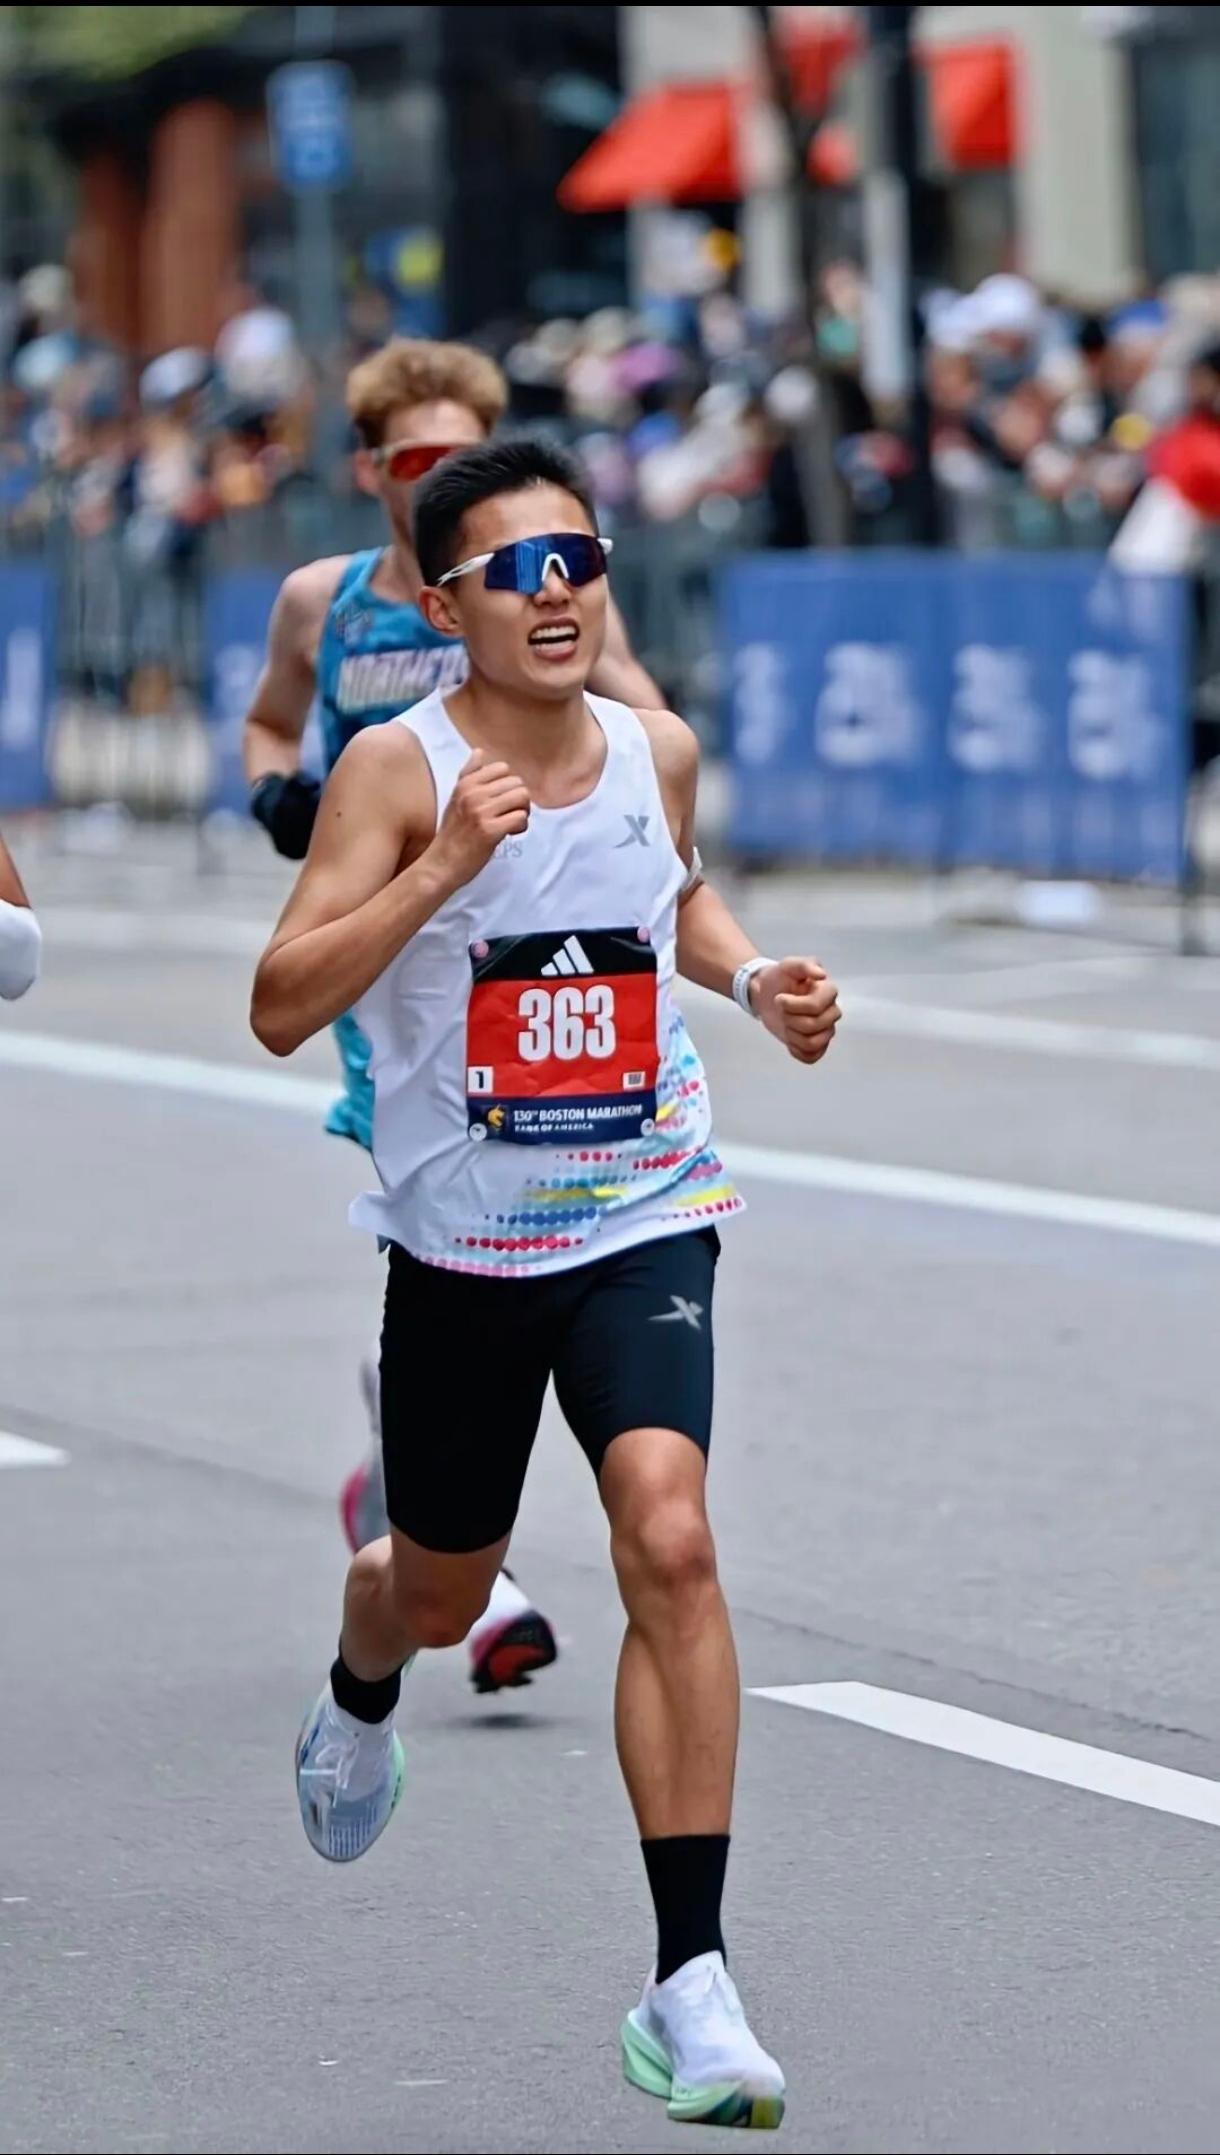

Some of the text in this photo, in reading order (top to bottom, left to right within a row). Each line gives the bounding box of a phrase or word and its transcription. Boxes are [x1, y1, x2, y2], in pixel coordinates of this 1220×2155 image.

[518, 985, 616, 1061] 363
[475, 1070, 485, 1090] 1
[539, 1107, 585, 1122] BOSTON
[587, 1104, 642, 1119] MARATHON
